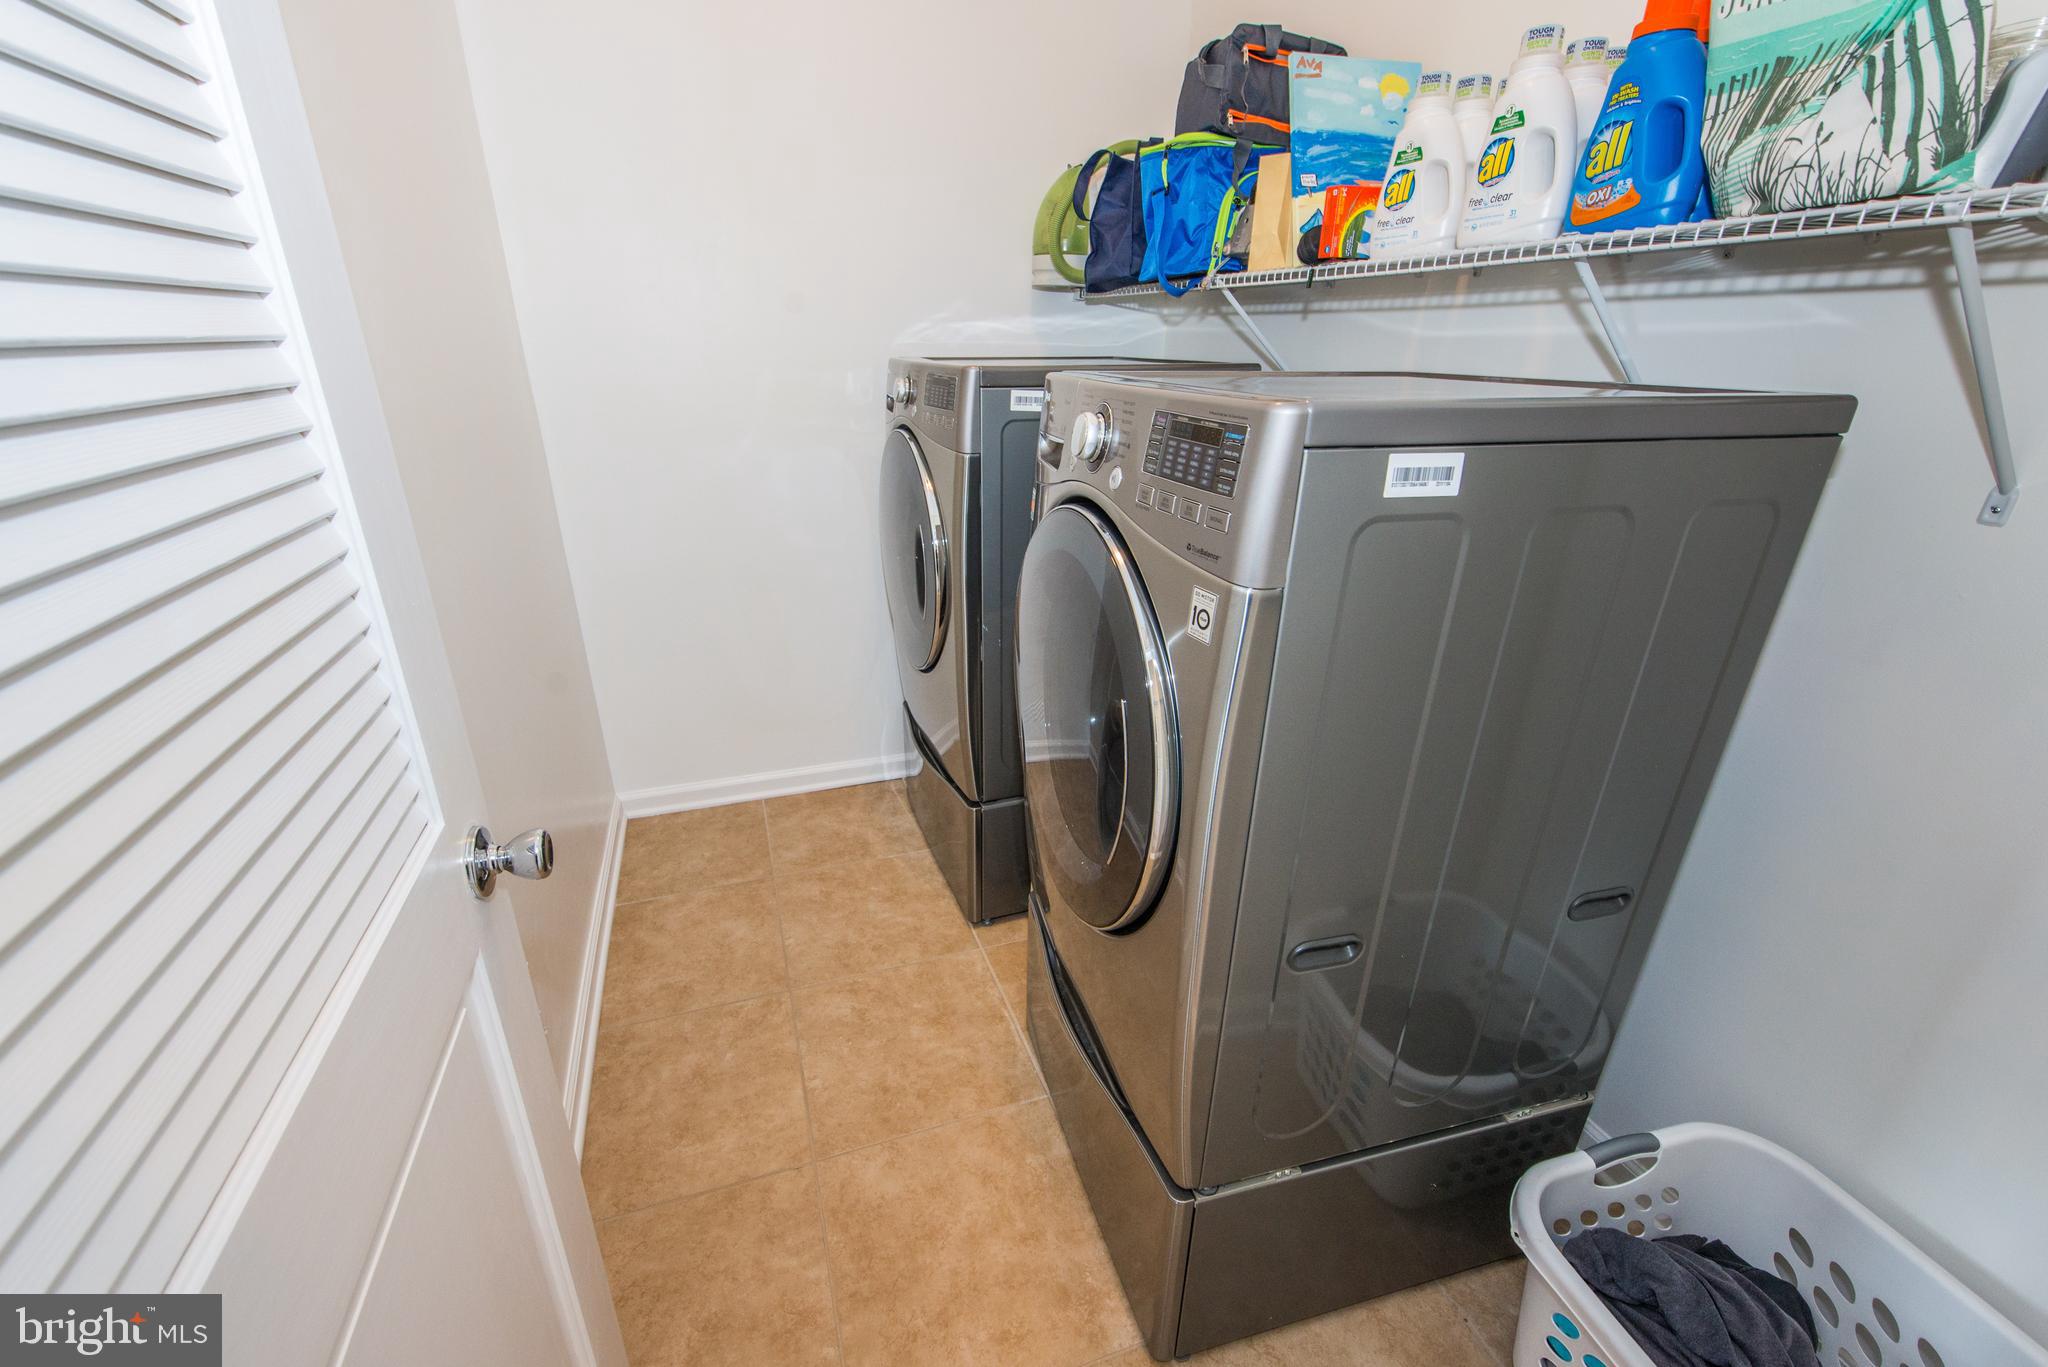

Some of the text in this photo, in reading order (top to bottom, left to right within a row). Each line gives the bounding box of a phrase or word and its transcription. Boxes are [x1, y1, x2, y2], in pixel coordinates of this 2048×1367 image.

[1529, 26, 1555, 36] TOUGH
[1296, 56, 1322, 72] AVA
[1585, 120, 1634, 179] all
[1478, 138, 1515, 184] all
[1384, 169, 1415, 208] all
[1468, 192, 1513, 207] free clear
[1586, 184, 1612, 206] OXI
[1377, 215, 1415, 228] free clear
[1191, 605, 1210, 630] 10
